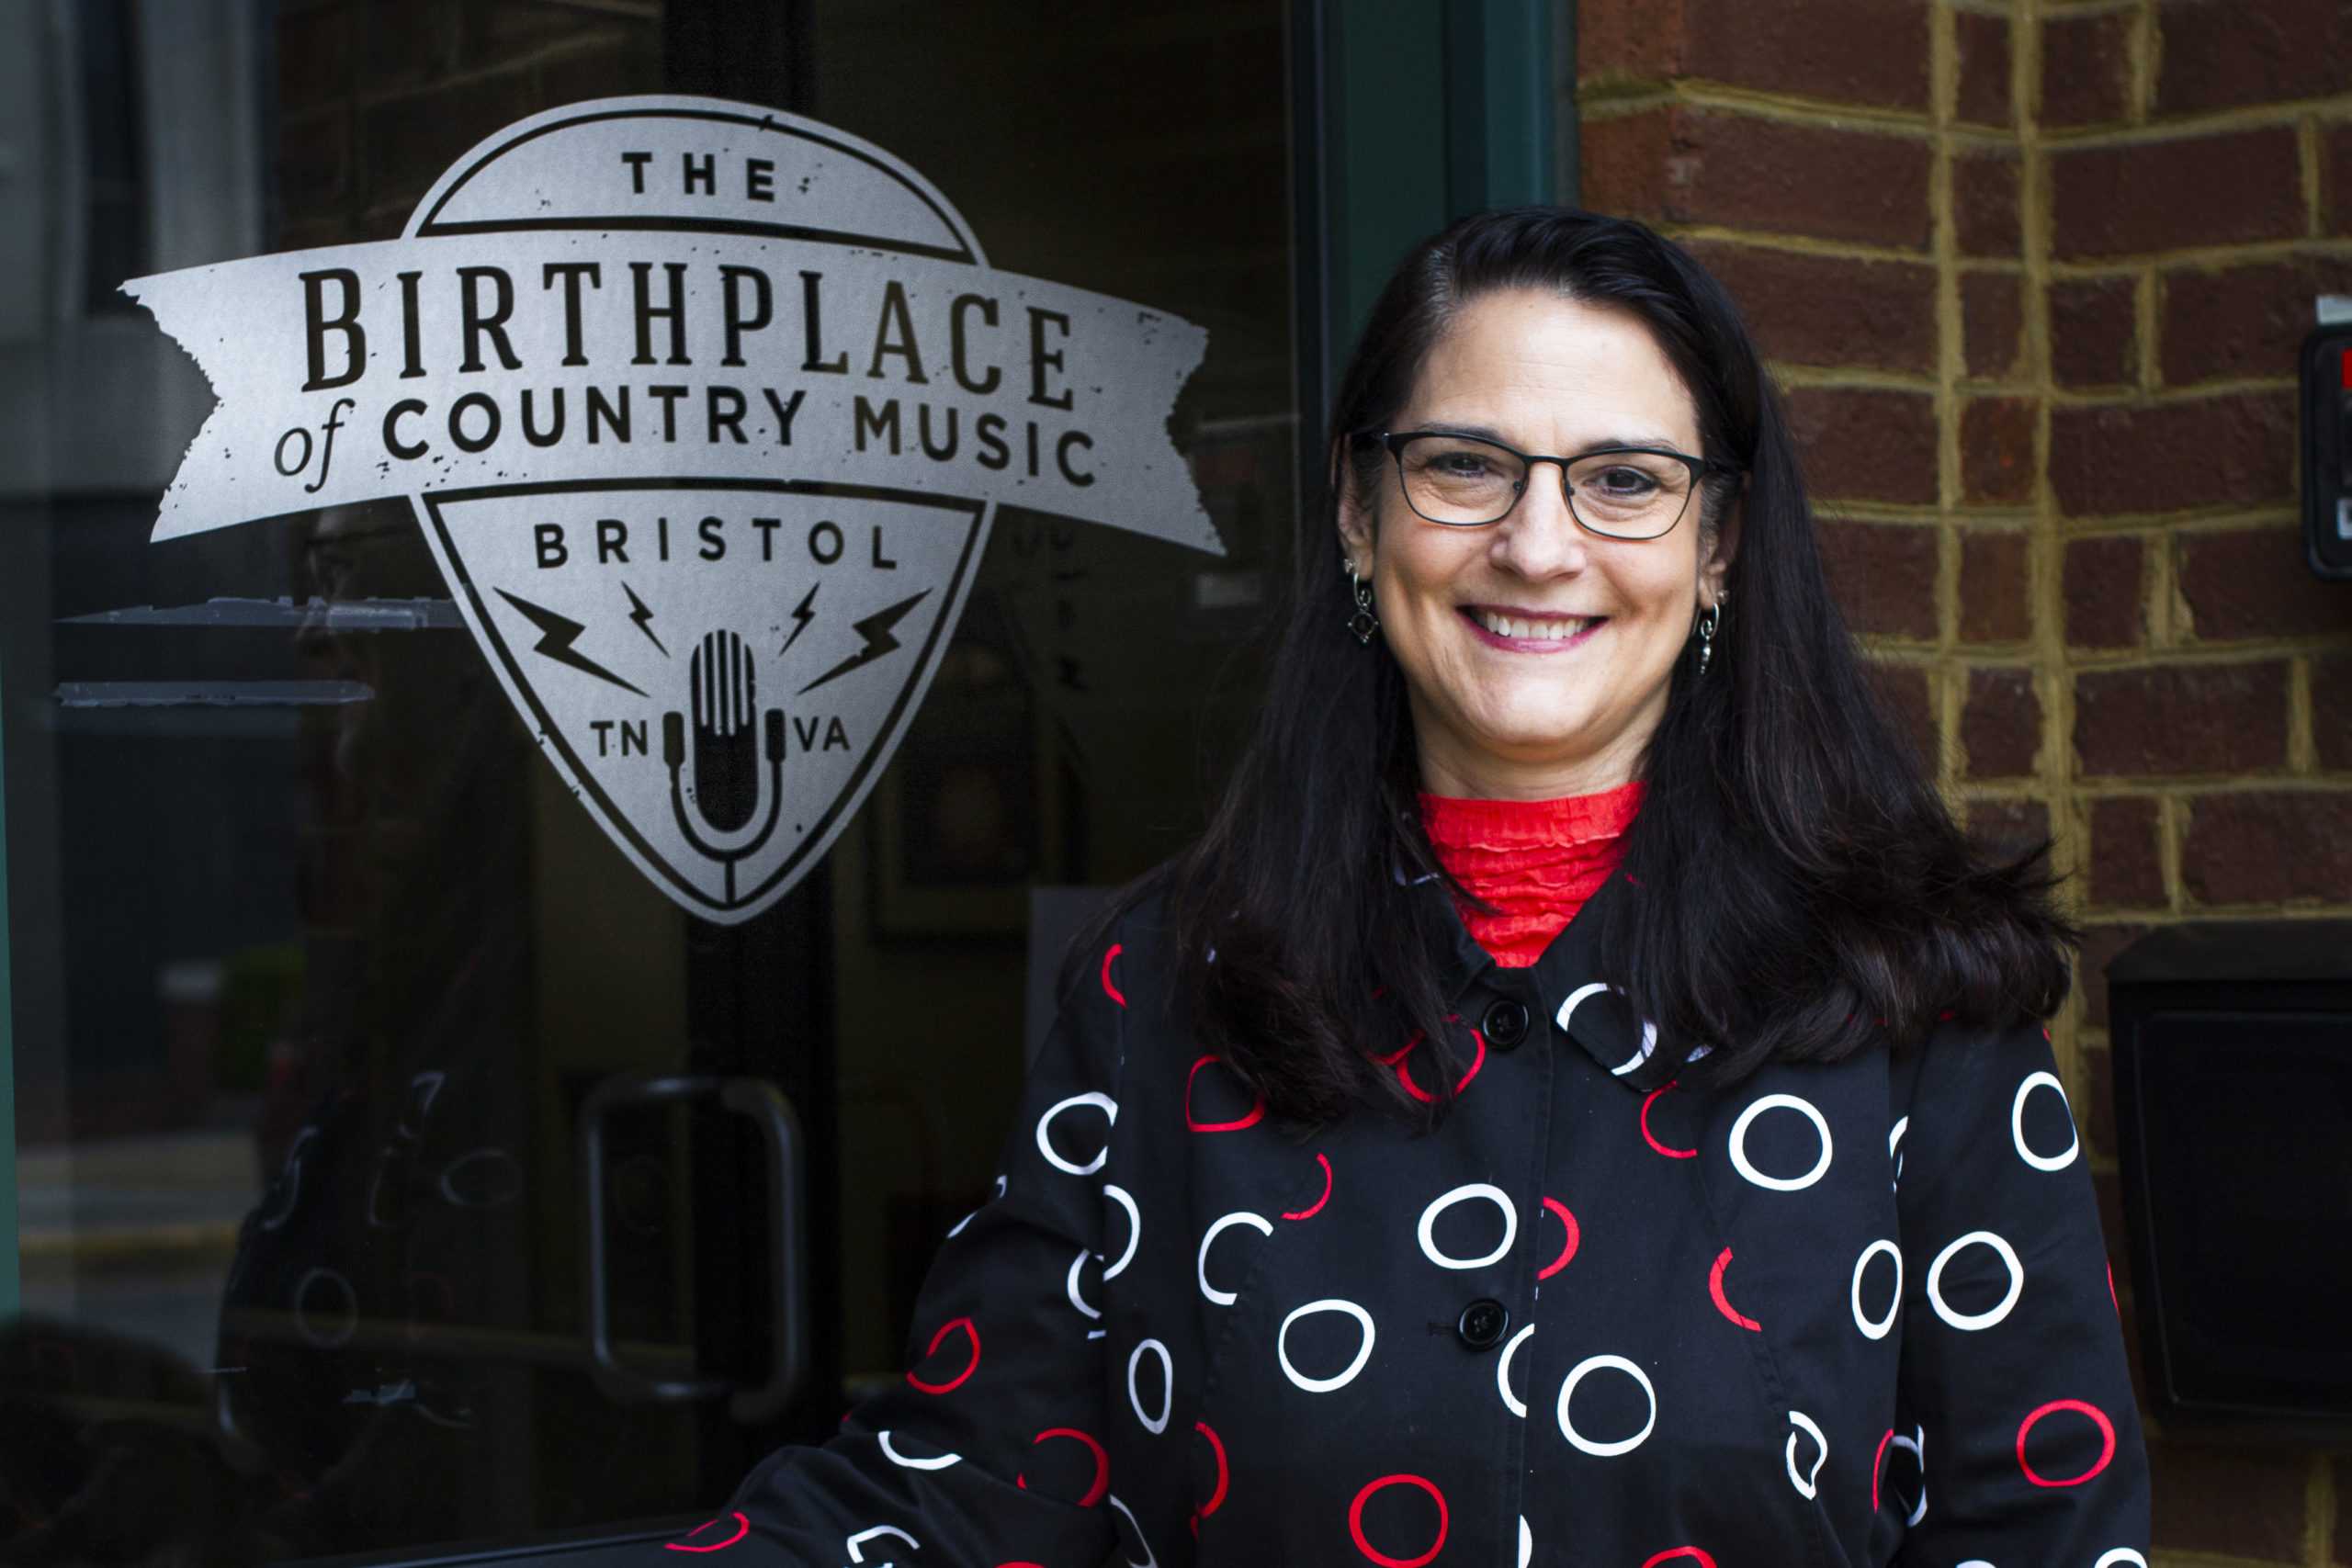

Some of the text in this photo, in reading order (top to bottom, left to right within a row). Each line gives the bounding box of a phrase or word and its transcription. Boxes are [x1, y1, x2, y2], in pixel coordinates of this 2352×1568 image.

[621, 152, 775, 202] THE
[298, 261, 1073, 411] BIRTHPLACE
[274, 385, 1095, 492] of COUNTRY MUSIC
[533, 516, 897, 570] BRISTOL
[589, 716, 850, 757] TN VA
